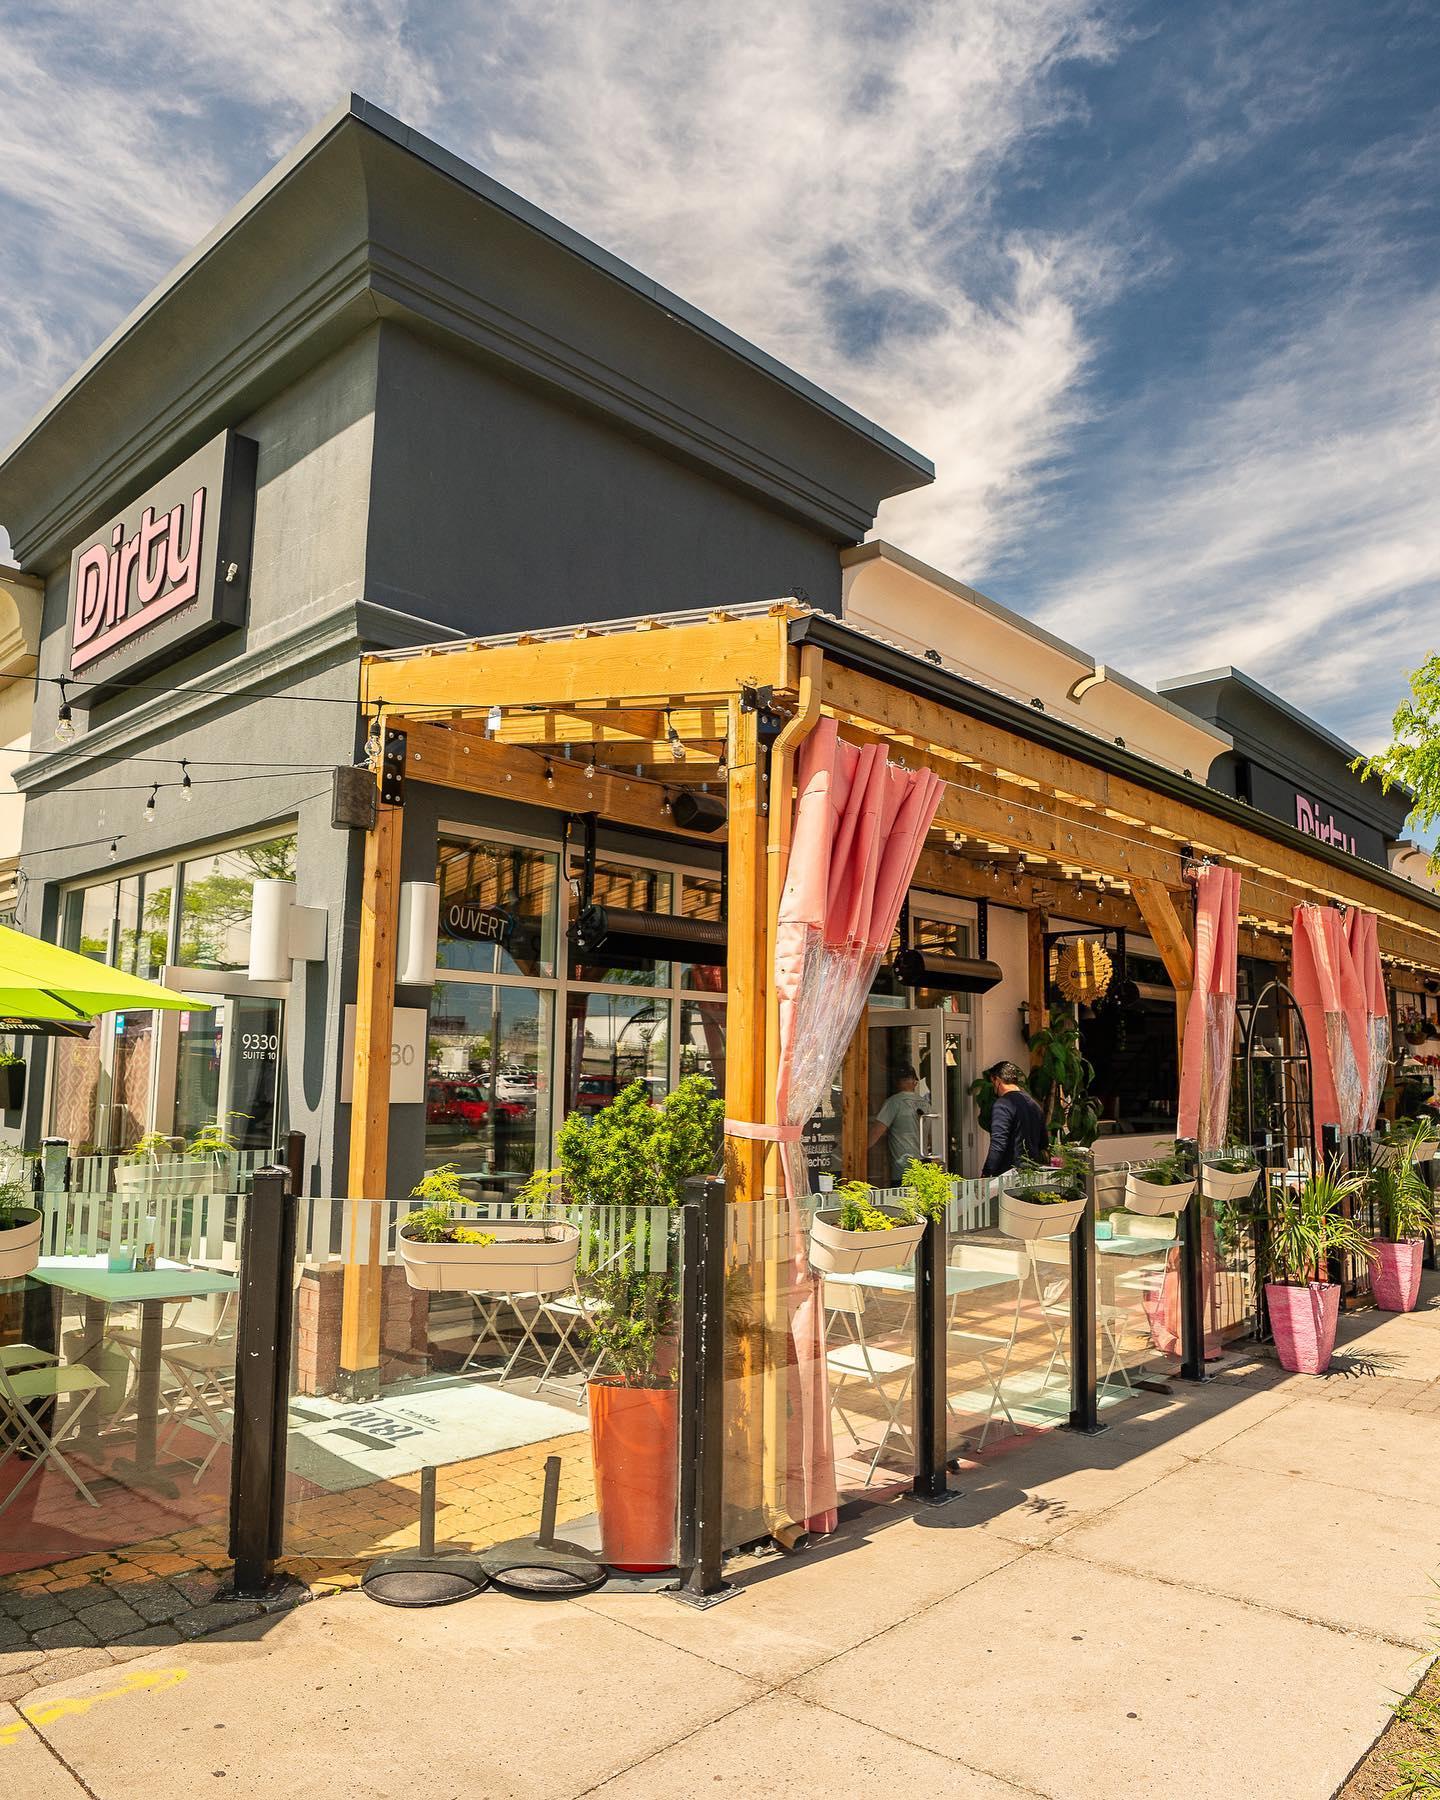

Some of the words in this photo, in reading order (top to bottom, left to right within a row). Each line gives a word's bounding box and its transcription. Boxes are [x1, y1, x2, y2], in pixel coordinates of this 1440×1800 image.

[71, 486, 207, 671] Dirty
[449, 905, 509, 941] OUVERT
[242, 1033, 278, 1051] 9330
[242, 1051, 265, 1060] SUITE
[267, 1052, 277, 1060] 10
[808, 1156, 831, 1167] achos
[333, 1410, 424, 1441] 1800
